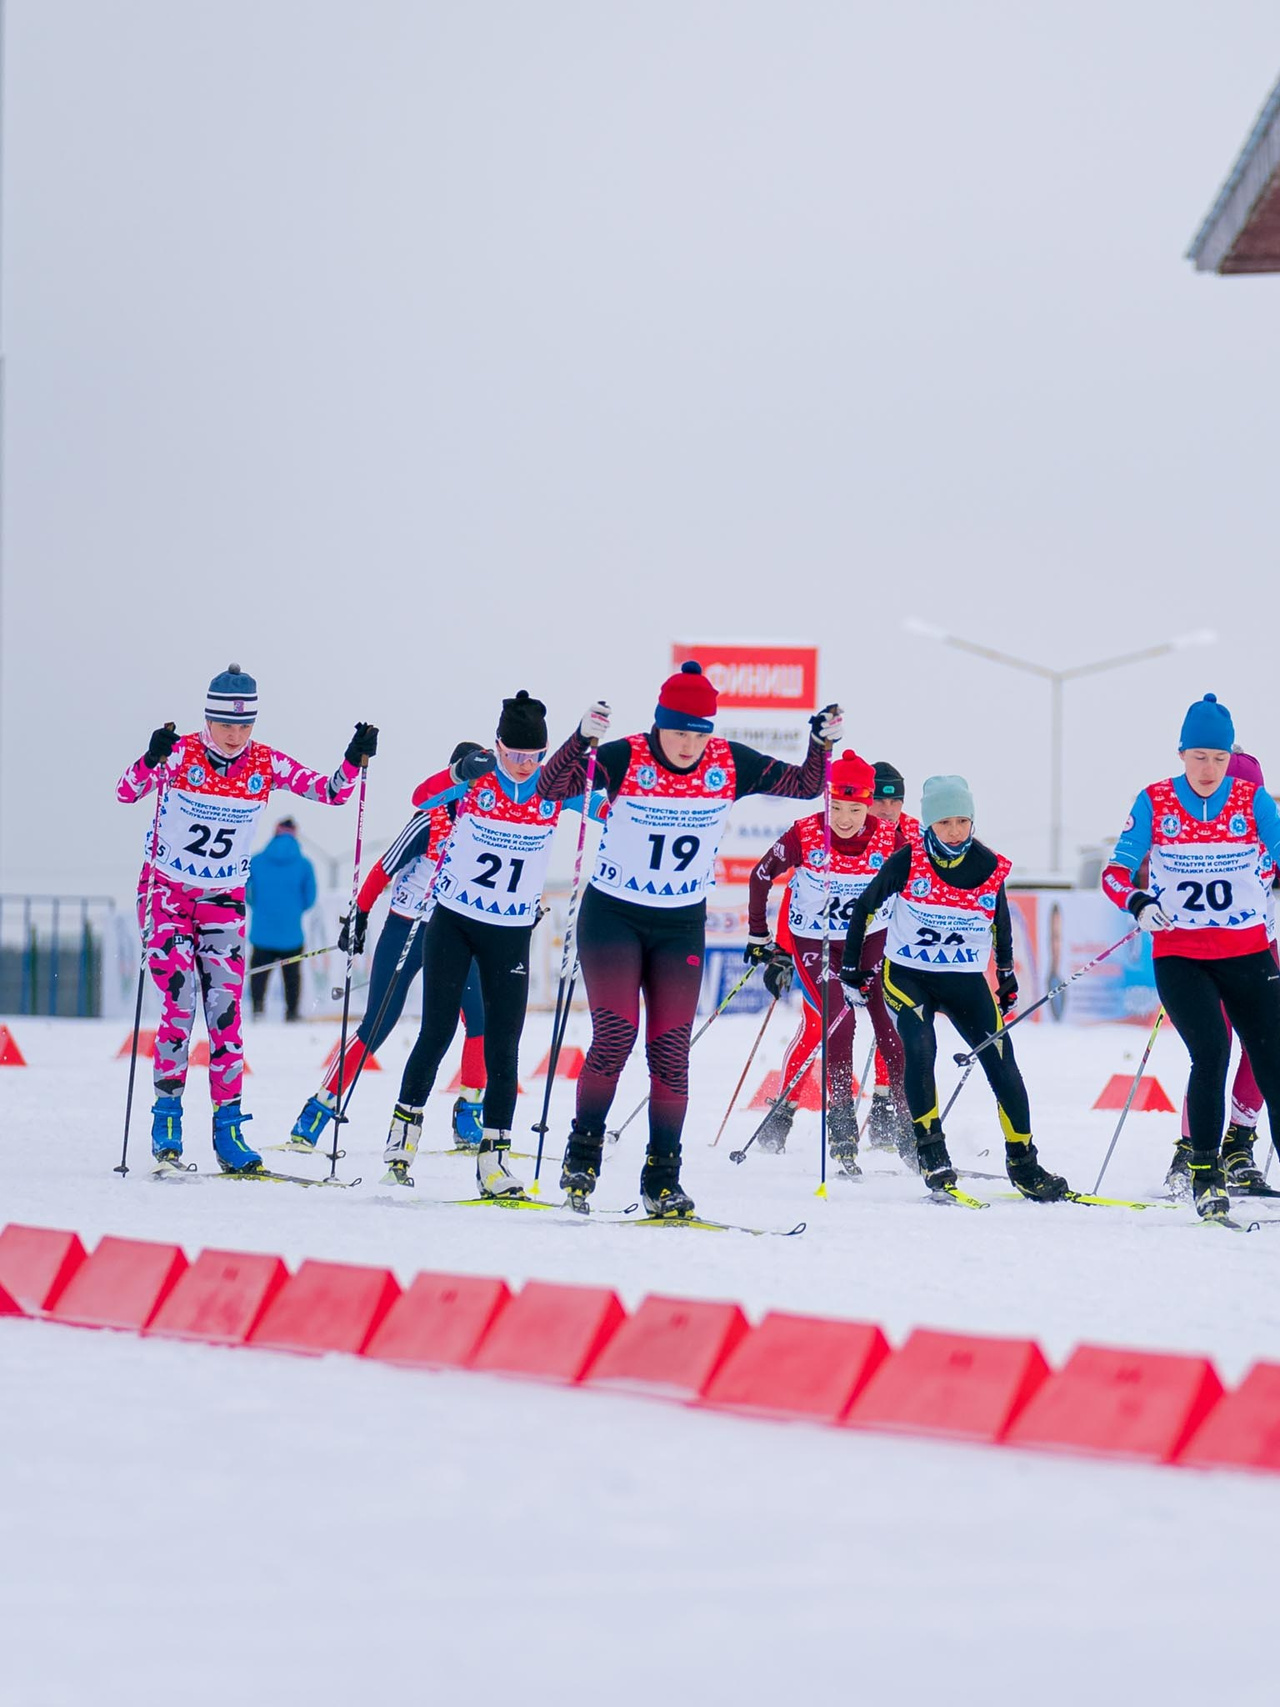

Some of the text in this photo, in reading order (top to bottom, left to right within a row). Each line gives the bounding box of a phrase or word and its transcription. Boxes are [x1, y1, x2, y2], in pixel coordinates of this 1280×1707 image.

[705, 662, 804, 698] ФИНИШ
[182, 823, 237, 859] 25
[648, 833, 700, 872] 19
[169, 857, 237, 878] АЛДАН
[241, 859, 250, 872] 2
[470, 852, 525, 893] 21
[599, 862, 617, 880] 19
[455, 890, 531, 916] АЛДАН
[1176, 879, 1233, 911] 20
[896, 944, 979, 963] АЛДАН
